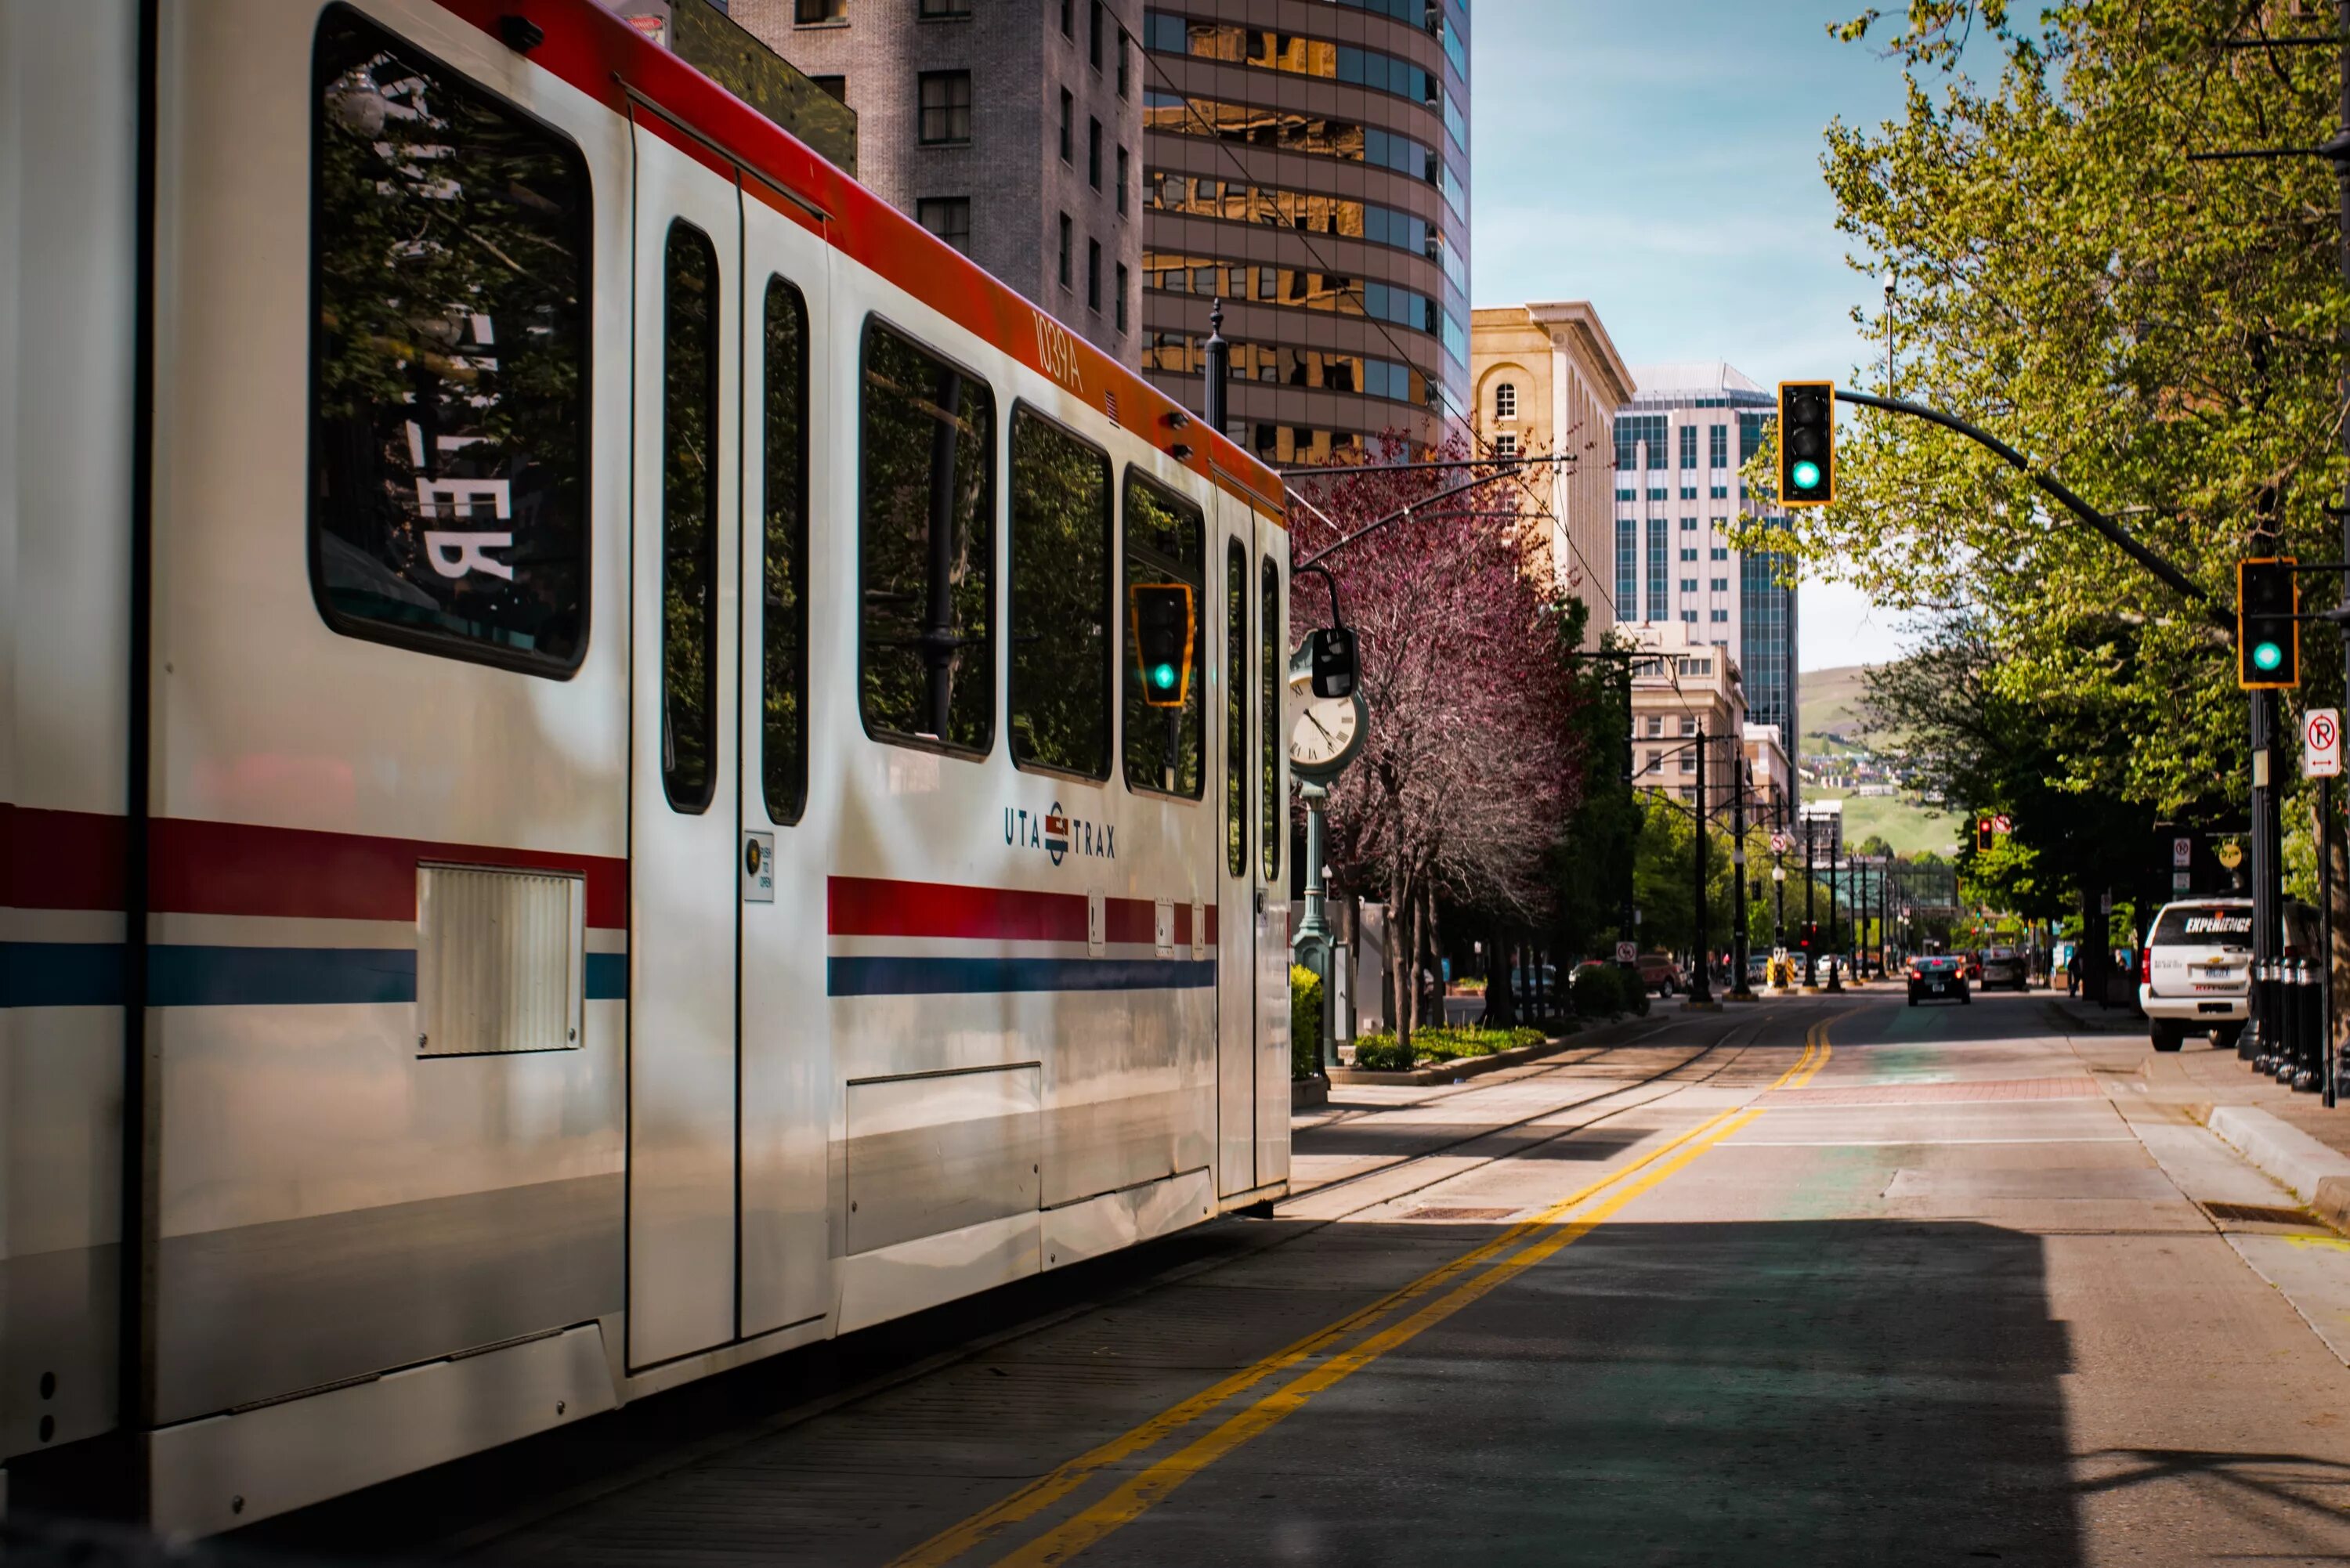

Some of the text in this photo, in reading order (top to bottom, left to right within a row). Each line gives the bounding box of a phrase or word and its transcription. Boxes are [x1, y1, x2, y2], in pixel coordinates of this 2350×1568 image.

[1032, 310, 1083, 394] 1039A
[1005, 807, 1115, 859] UTA TRAX
[2185, 917, 2252, 934] EXPERIENCE
